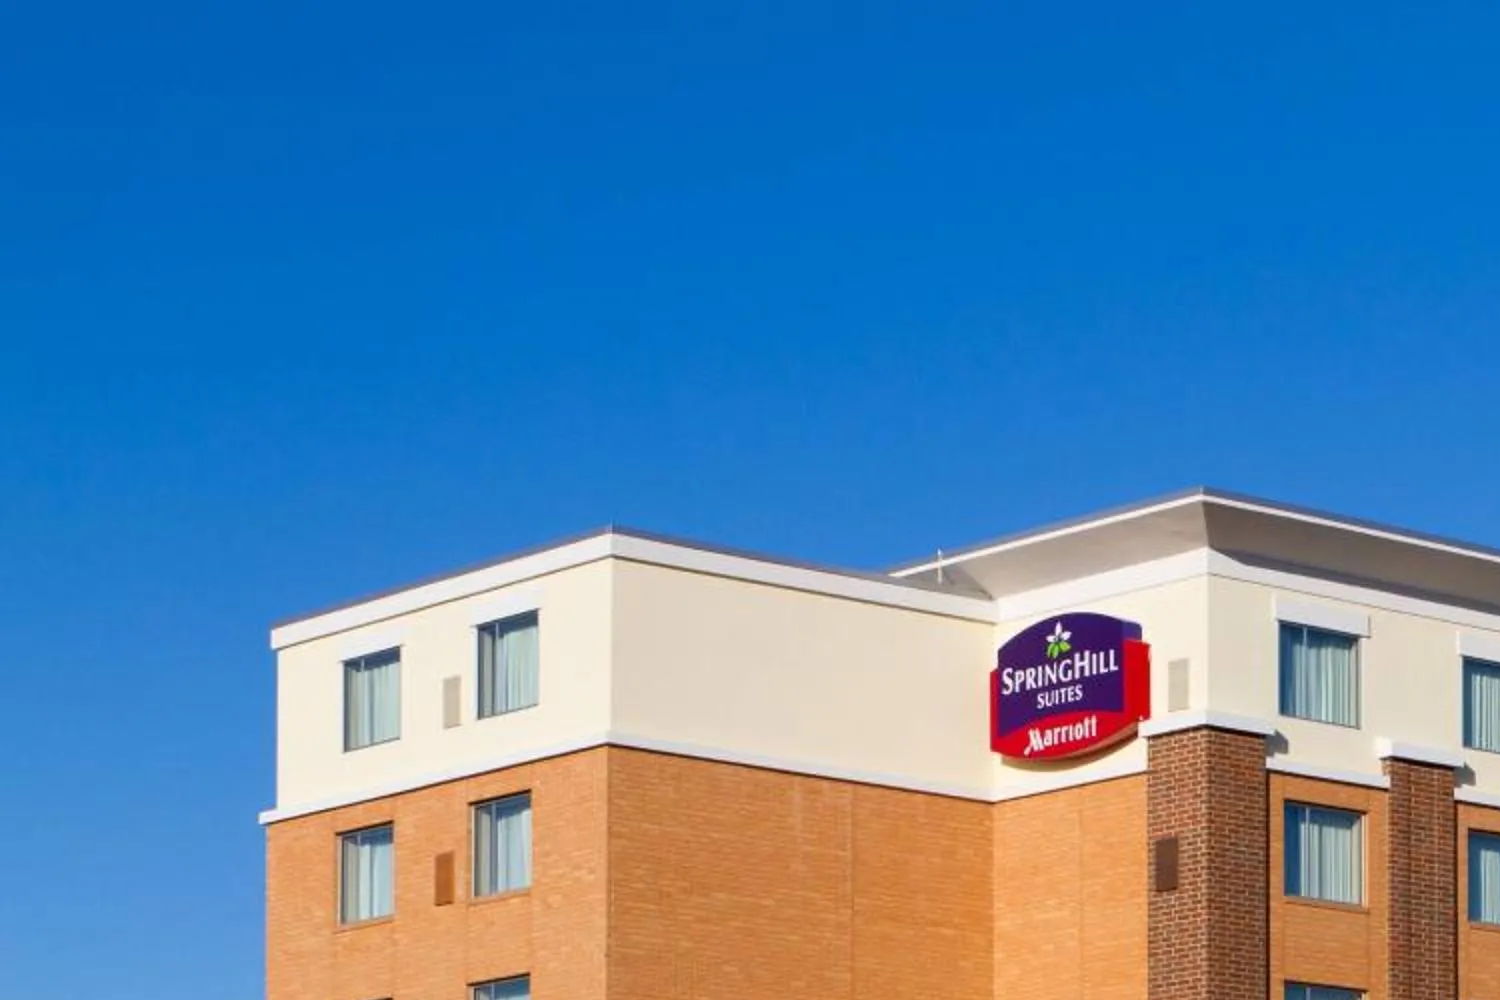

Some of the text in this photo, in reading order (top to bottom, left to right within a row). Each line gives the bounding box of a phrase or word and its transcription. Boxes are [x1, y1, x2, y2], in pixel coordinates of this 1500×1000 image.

[1001, 649, 1119, 695] SPRINGHILL
[1036, 684, 1083, 709] SUITES
[1023, 715, 1097, 756] Marriott
